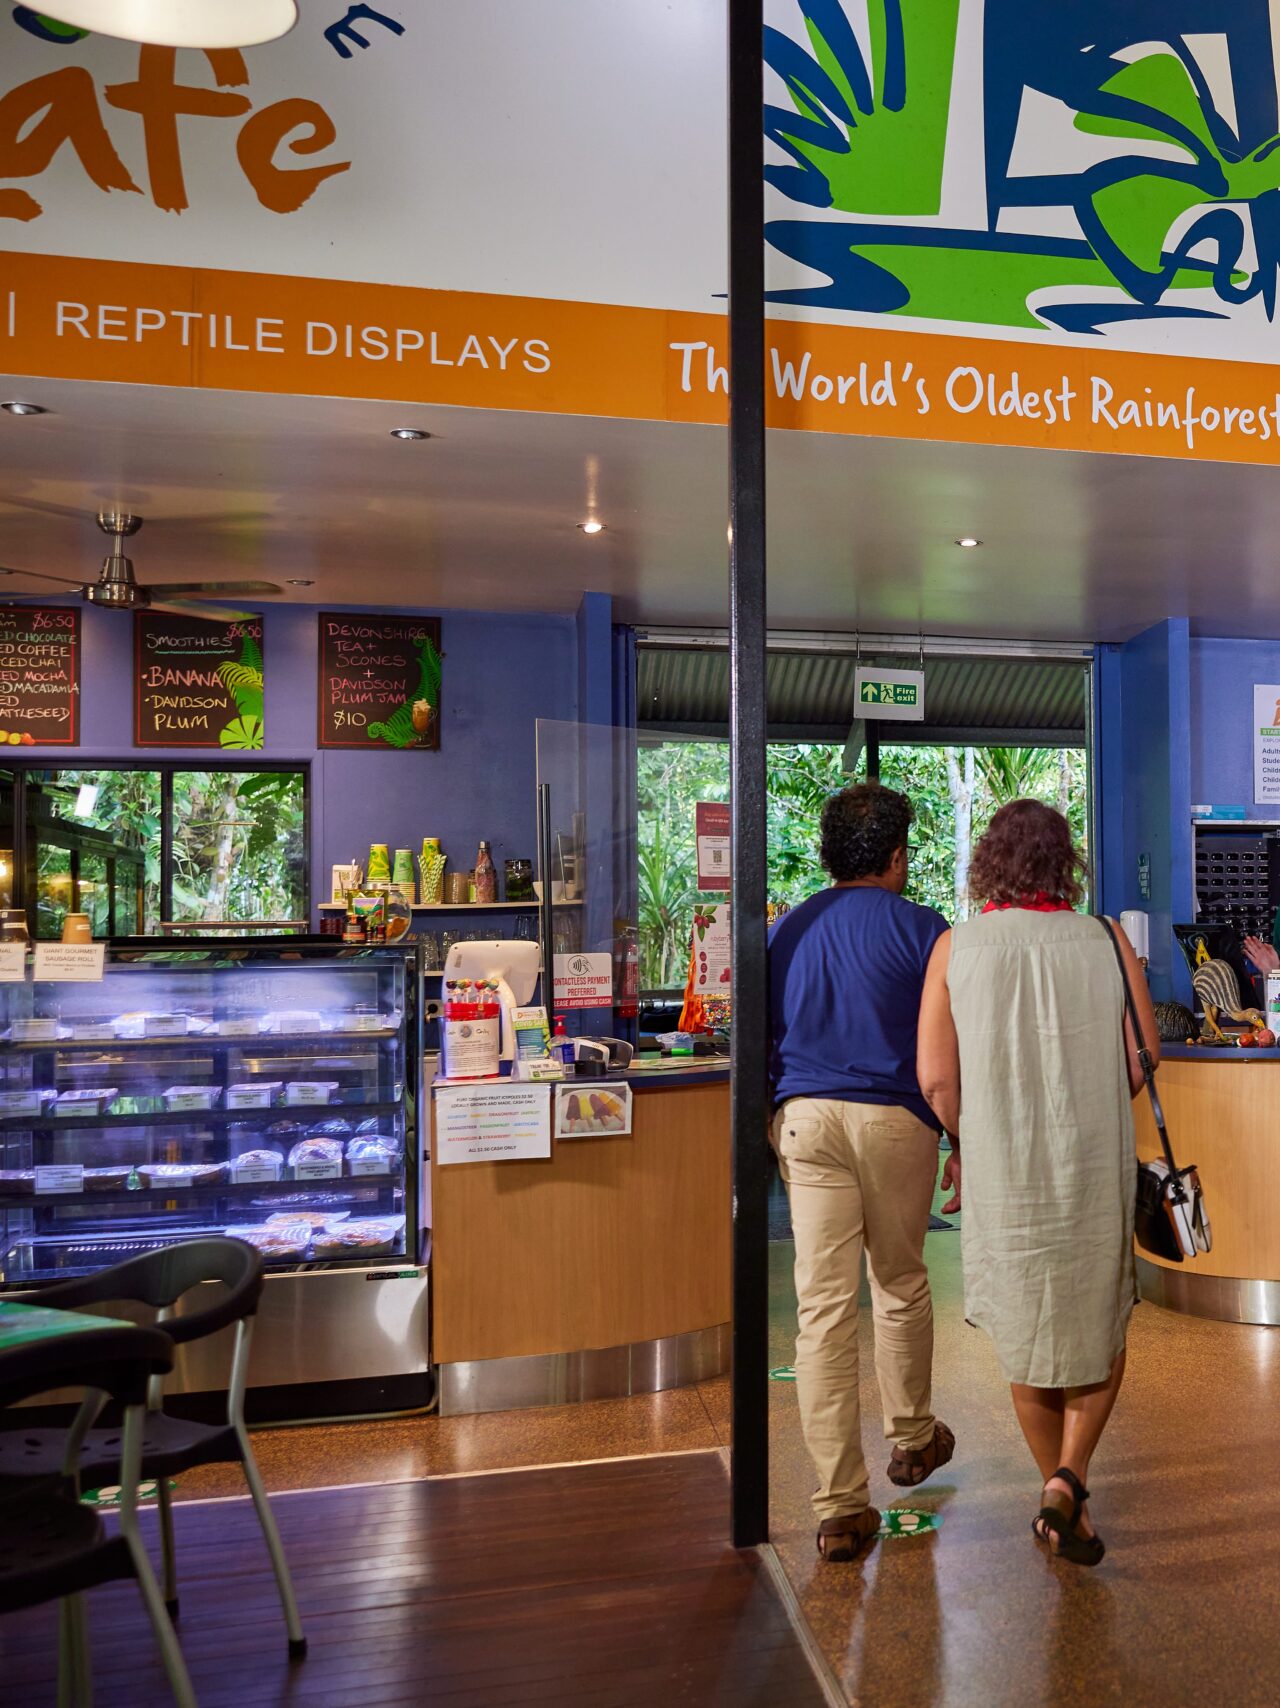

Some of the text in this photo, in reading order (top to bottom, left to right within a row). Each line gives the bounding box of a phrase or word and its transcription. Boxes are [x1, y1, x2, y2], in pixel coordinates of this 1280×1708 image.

[0, 43, 351, 222] afe
[57, 301, 551, 373] REPTILE DISPLAYS
[669, 342, 730, 393] Th
[771, 347, 928, 414] World's
[945, 366, 1076, 424] Oldest
[16, 631, 77, 644] CHOCOLATE
[327, 623, 426, 640] DEVONSHIRE
[146, 633, 233, 649] SMOOTHIES
[333, 640, 364, 652] TEA
[0, 644, 70, 657] ED COFFEE
[1, 658, 61, 668] CED CHAI
[336, 654, 407, 667] SCONES
[0, 670, 68, 681] ED MOCHA
[147, 666, 224, 688] BANANA
[329, 677, 407, 690] DAVIDSON
[0, 695, 19, 706] ED
[150, 695, 227, 709] DAVIDSON
[331, 691, 407, 704] PLUM JAM
[0, 708, 70, 721] ATTLESEED
[334, 709, 367, 730] $10
[154, 713, 209, 731] PLUM
[554, 976, 610, 985] ONTACTLESS PAYMENT
[568, 988, 596, 996] PREFERRED
